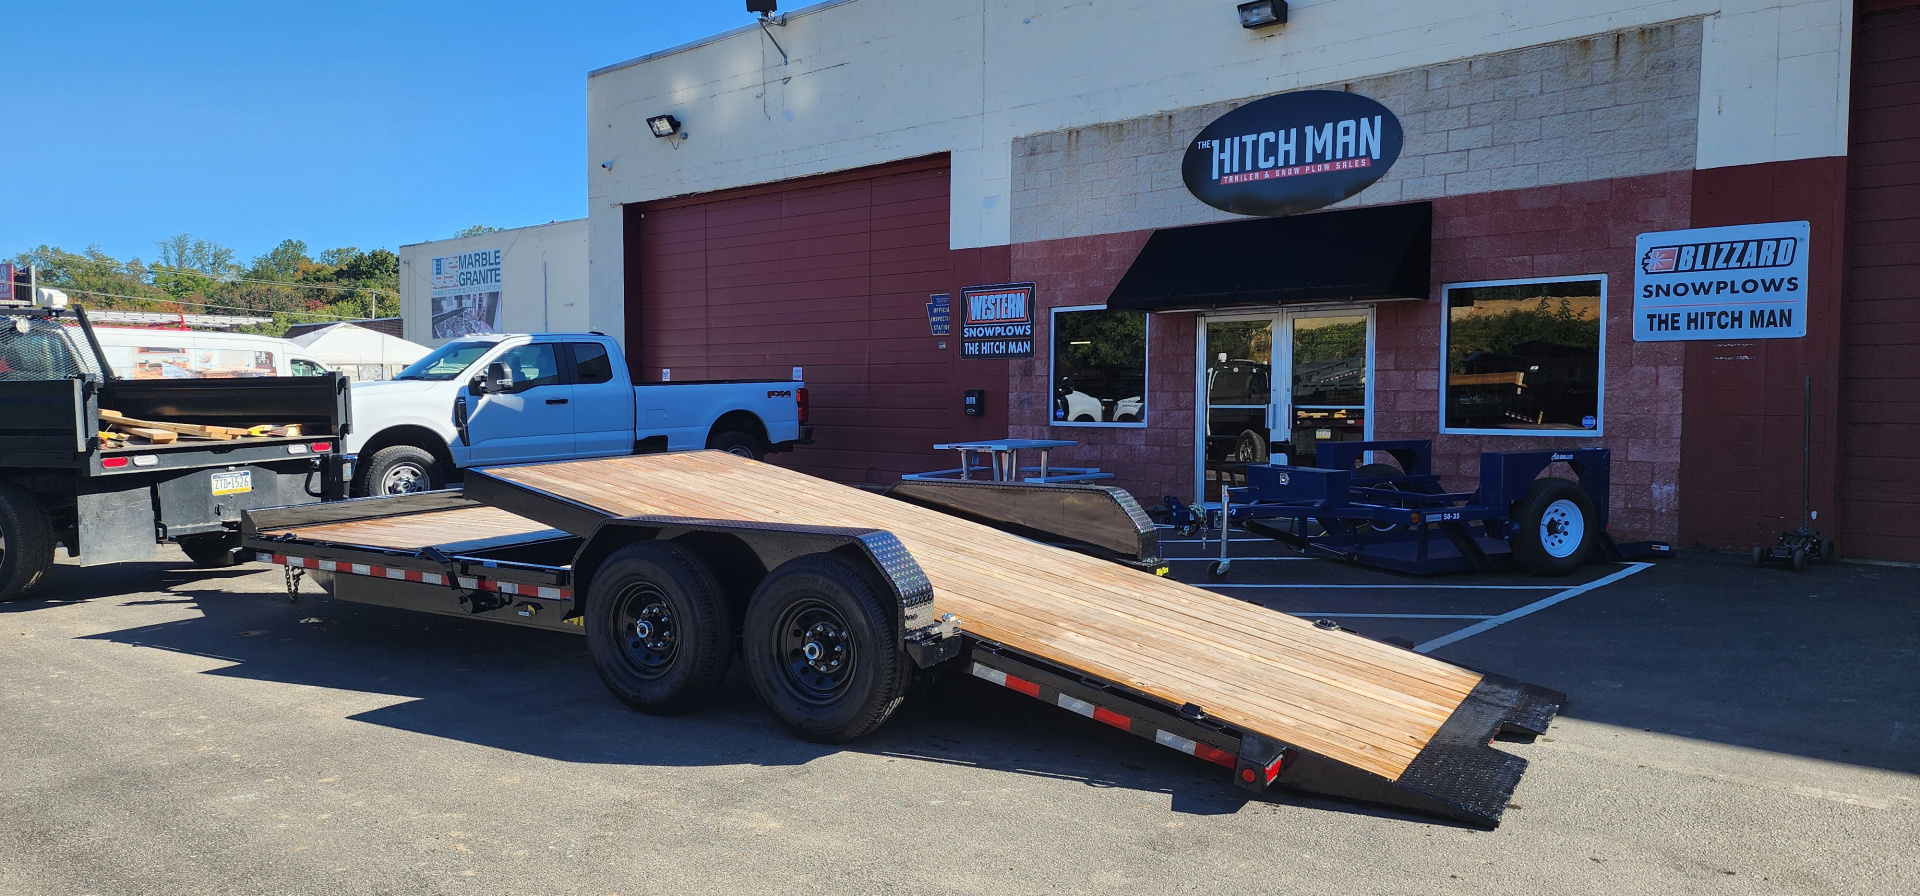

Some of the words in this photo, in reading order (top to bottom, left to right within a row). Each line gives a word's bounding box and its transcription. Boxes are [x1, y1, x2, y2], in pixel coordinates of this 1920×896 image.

[1197, 139, 1211, 150] THE
[1212, 127, 1297, 180] HITCH
[1305, 115, 1382, 163] MAN
[1223, 172, 1259, 184] TRAILER
[1276, 166, 1300, 177] SNOW
[1305, 163, 1331, 173] PLOW
[1336, 158, 1366, 170] SALES
[458, 250, 501, 270] MARBLE
[1677, 239, 1795, 272] BLIZZARD
[458, 267, 501, 287] GRANITE
[1642, 276, 1799, 299] SNOWPLOWS
[970, 292, 1025, 321] WESTERN
[963, 325, 1031, 338] SNOWPLOWS
[1647, 312, 1681, 332] THE
[1686, 310, 1743, 331] HITCH
[1750, 308, 1792, 329] MAN
[964, 342, 979, 355] THE
[981, 341, 1006, 354] HITCH
[1008, 340, 1031, 354] MAN
